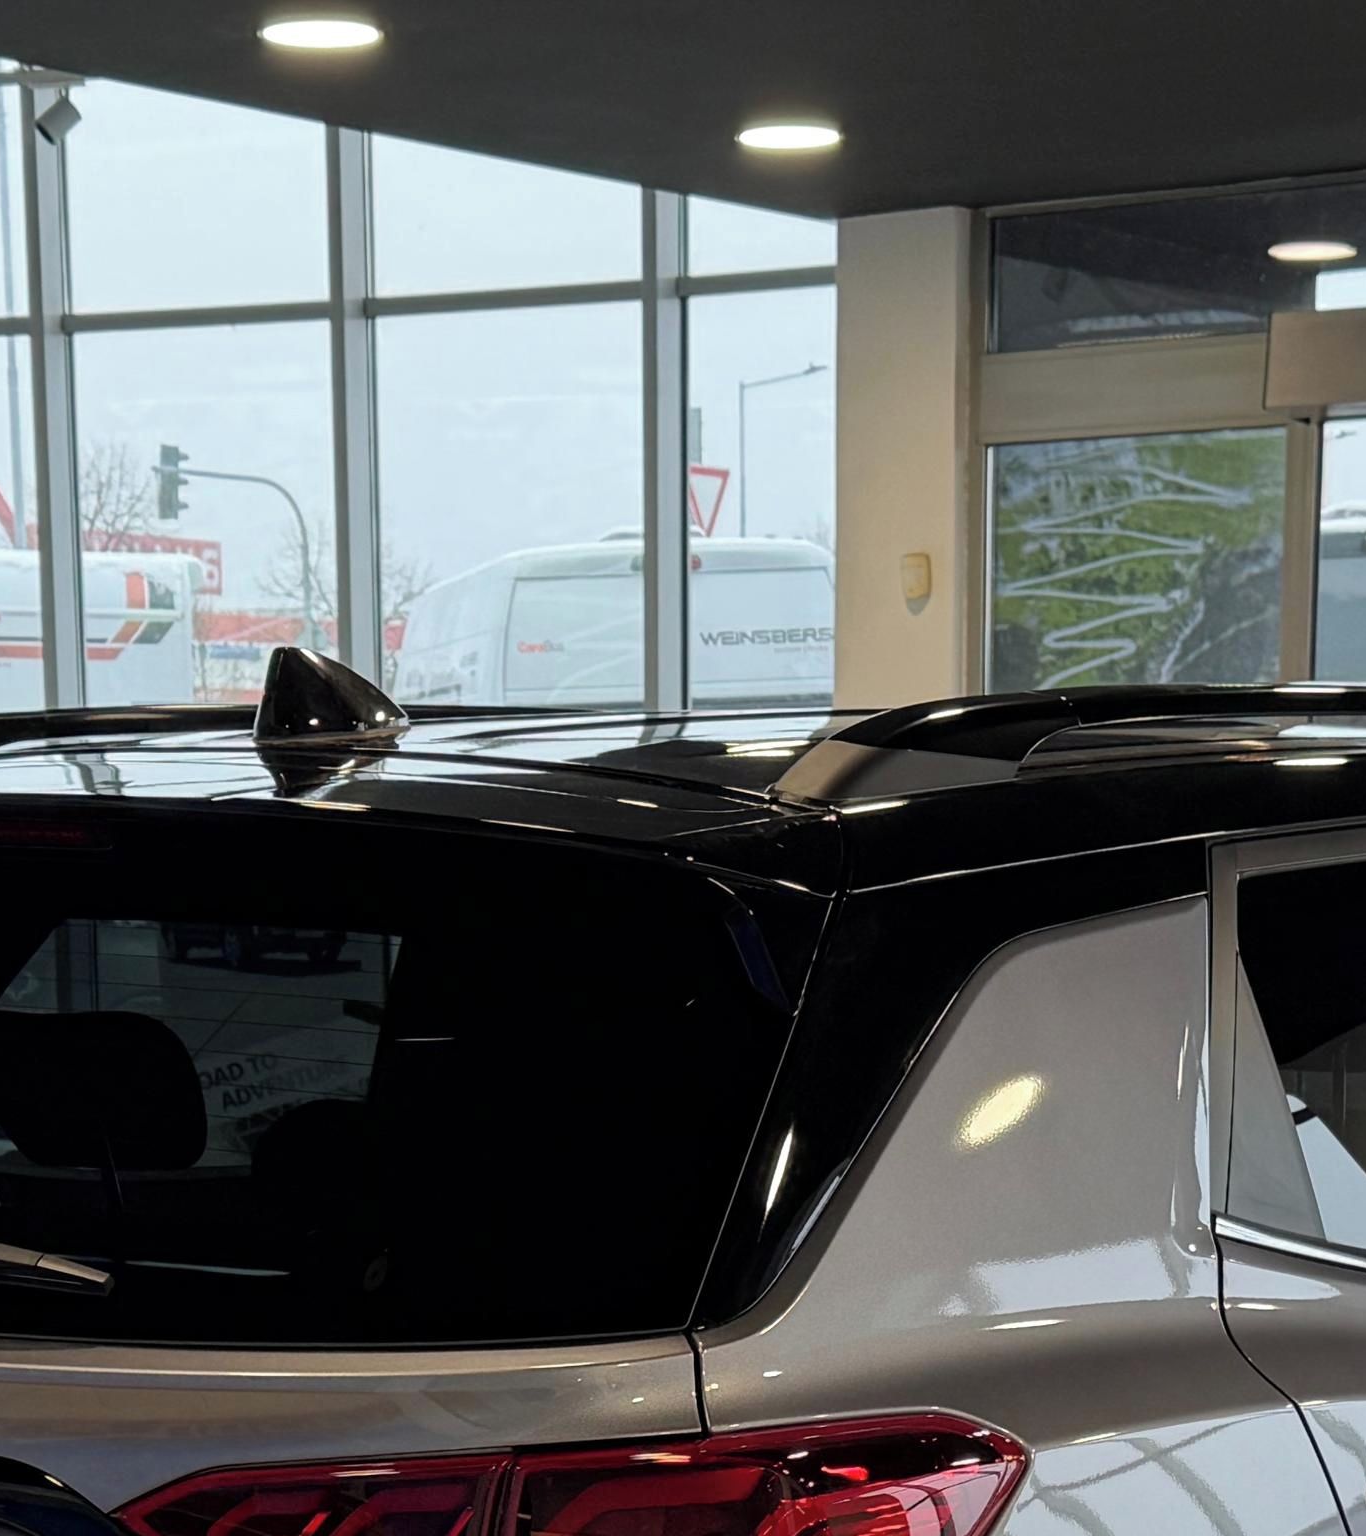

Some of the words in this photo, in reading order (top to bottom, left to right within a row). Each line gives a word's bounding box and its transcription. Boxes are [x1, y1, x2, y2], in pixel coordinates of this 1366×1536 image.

[699, 627, 835, 647] WEINSBERG
[200, 1062, 244, 1090] OAD
[245, 1053, 278, 1075] TO
